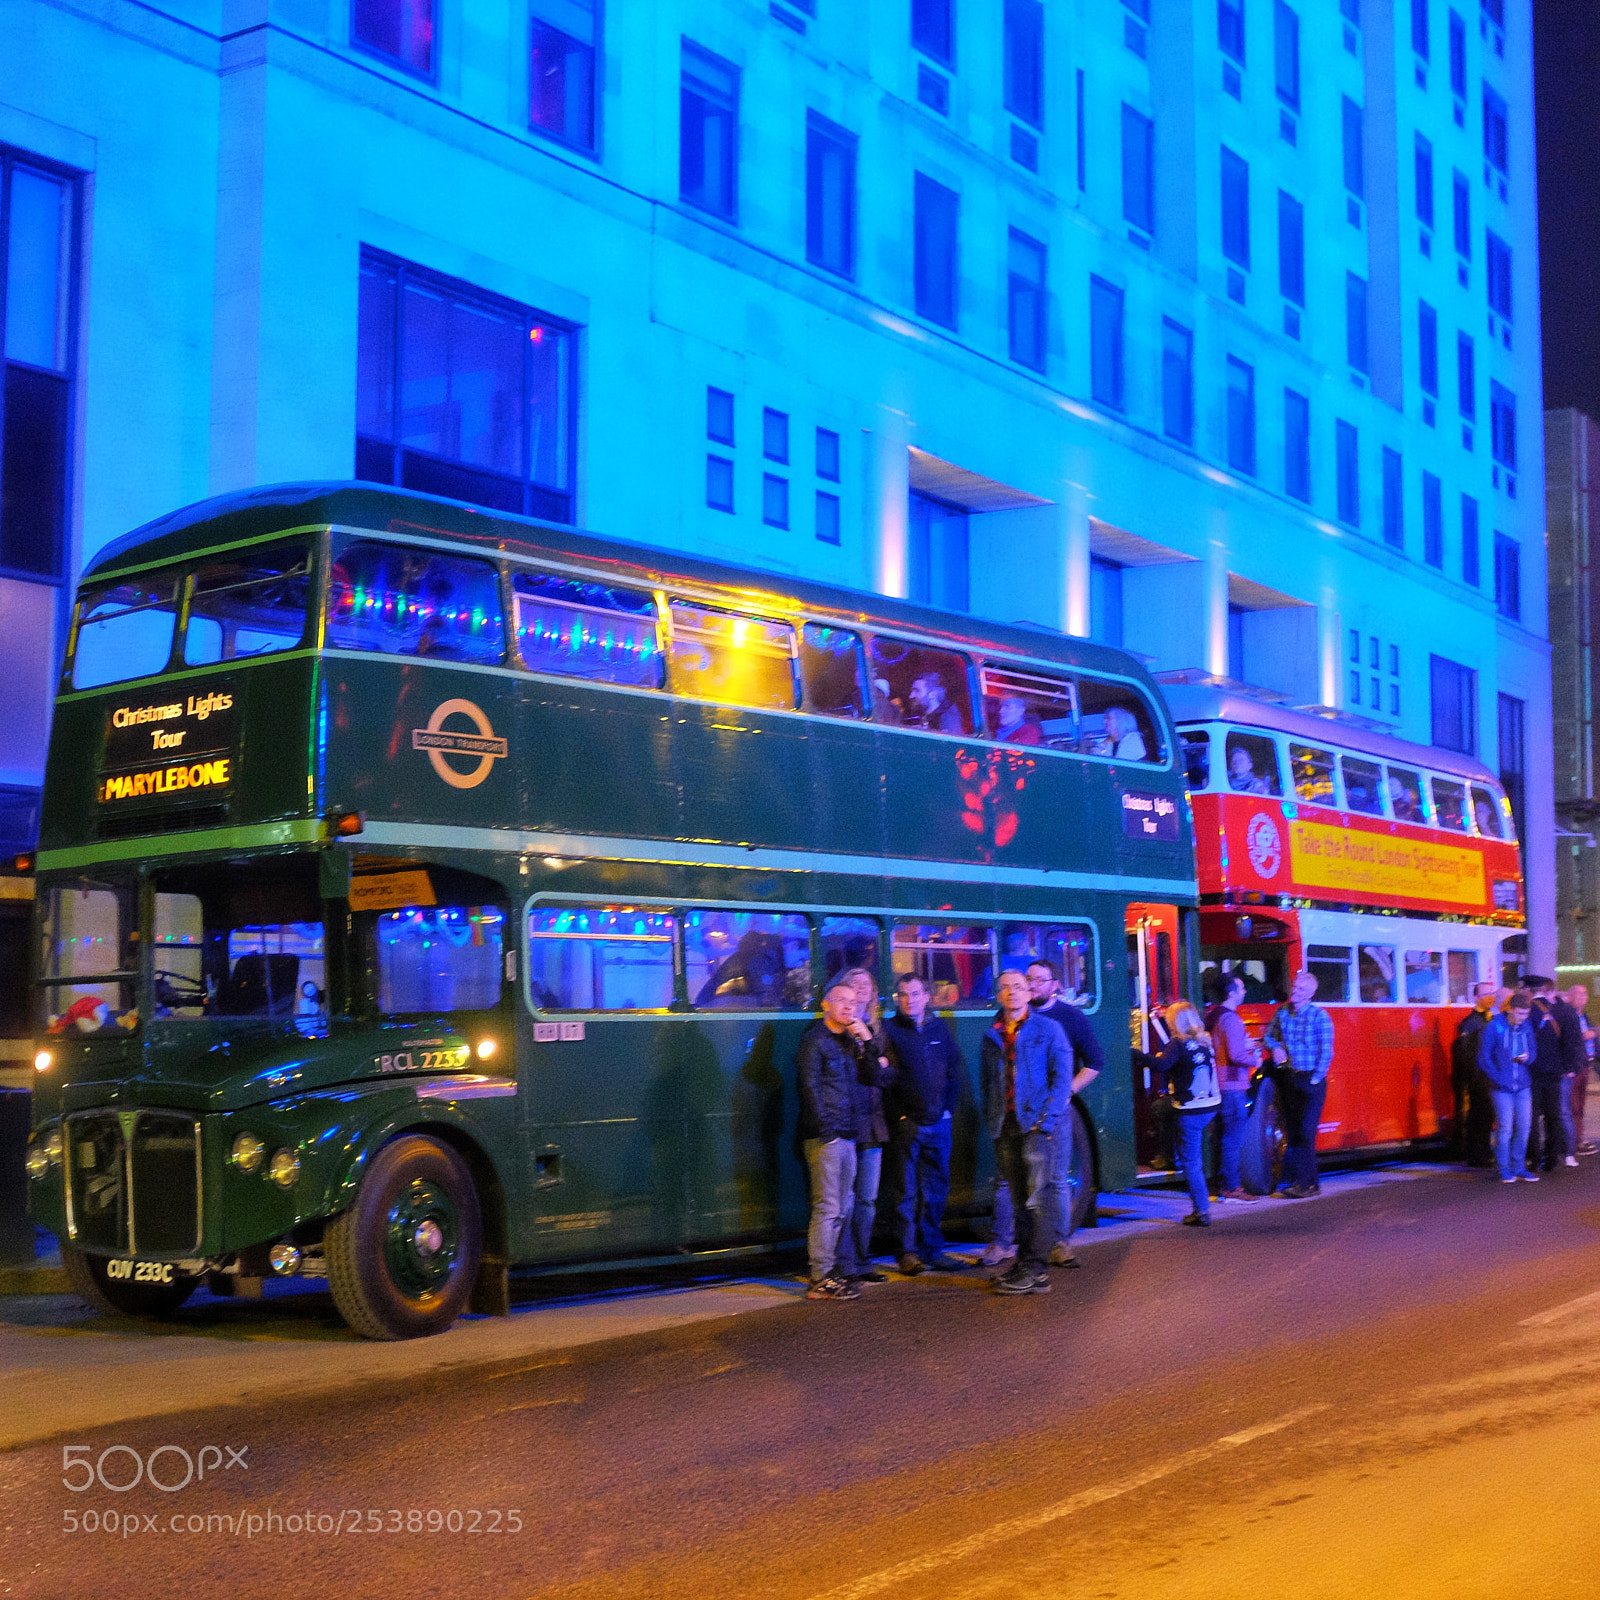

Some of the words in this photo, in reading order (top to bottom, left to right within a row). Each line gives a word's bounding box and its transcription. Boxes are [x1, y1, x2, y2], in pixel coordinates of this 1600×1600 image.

[112, 703, 183, 729] Christmas
[187, 692, 233, 721] Lights
[150, 729, 187, 750] Tour
[418, 735, 455, 746] LONDON
[105, 759, 230, 800] MARYLEBONE
[1297, 828, 1322, 856] Take
[1324, 834, 1342, 858] the
[1343, 836, 1375, 863] Round
[1375, 842, 1411, 868] London
[381, 1053, 419, 1072] RCL
[420, 1051, 467, 1069] 2233
[107, 1259, 134, 1279] CUV
[135, 1262, 173, 1283] 233C
